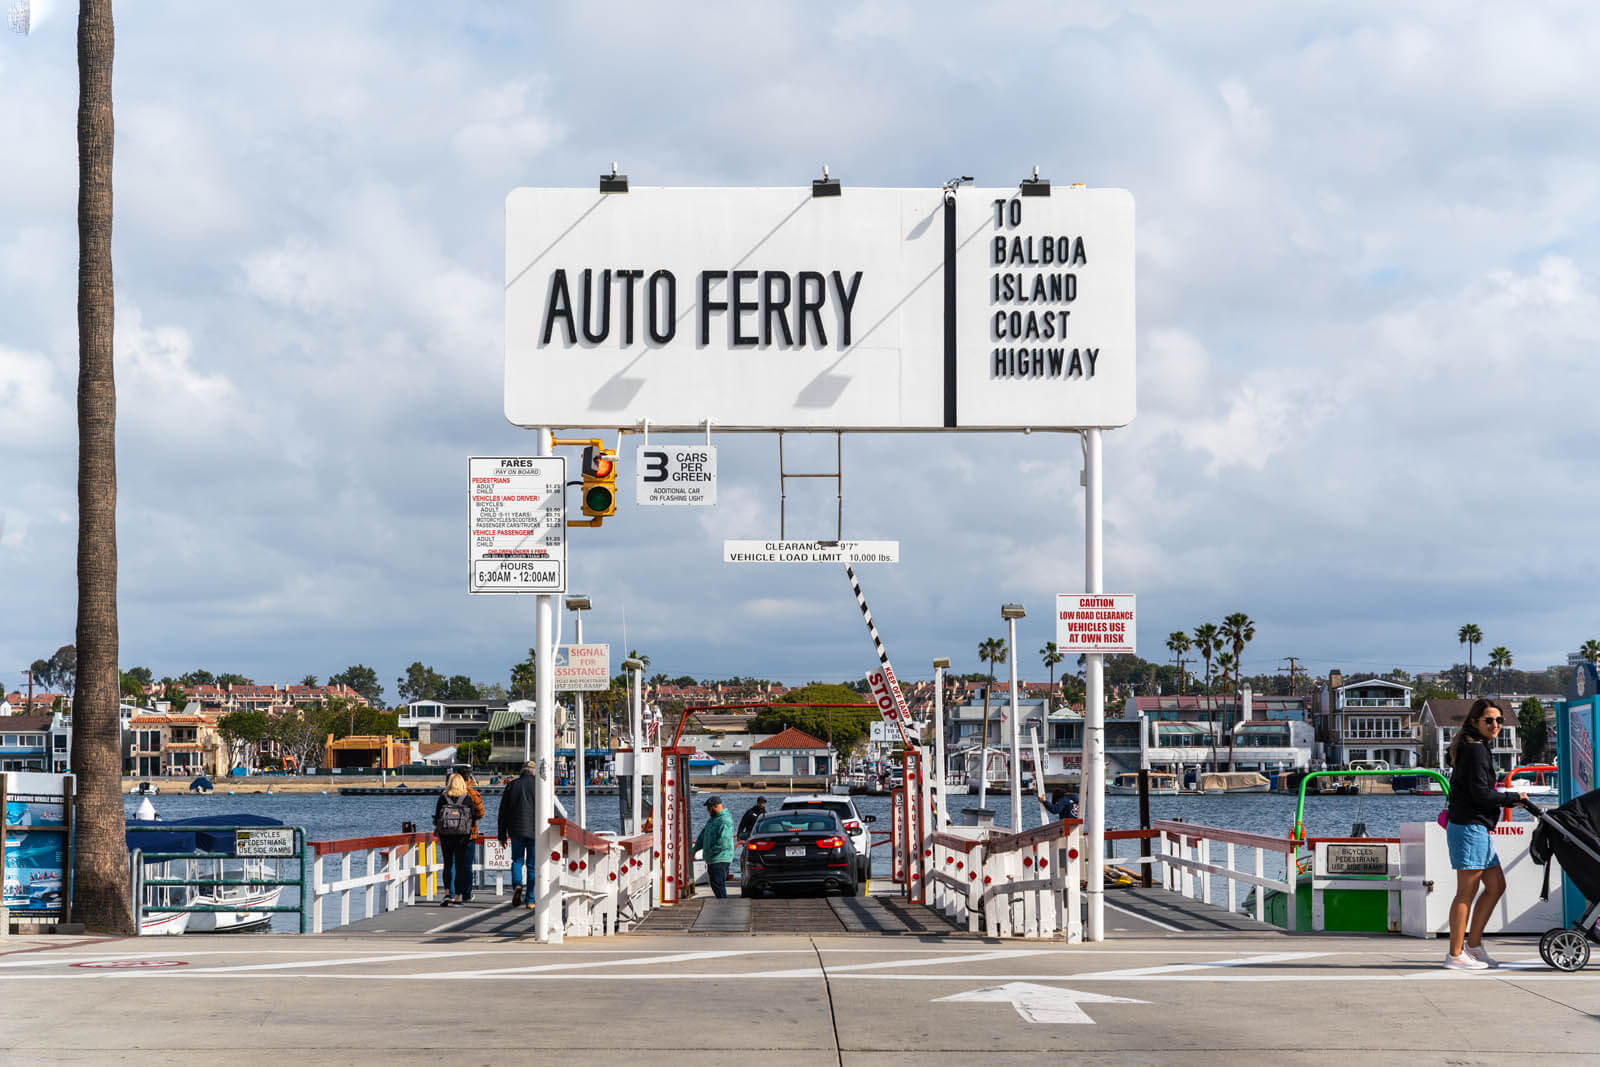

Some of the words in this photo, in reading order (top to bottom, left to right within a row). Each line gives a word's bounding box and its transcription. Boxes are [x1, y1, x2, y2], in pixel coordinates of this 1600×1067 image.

[994, 199, 1022, 227] TO
[995, 236, 1087, 265] BALBOA
[995, 273, 1077, 302] ISLAND
[542, 268, 677, 346] AUTO
[701, 270, 864, 347] FERRY
[995, 310, 1071, 340] COAST
[995, 347, 1101, 378] HIGHWAY
[676, 453, 708, 463] CARS
[501, 459, 534, 468] FARES
[643, 451, 669, 482] 3
[680, 463, 703, 472] PER
[672, 472, 712, 482] GREEN
[765, 543, 827, 551] CLEARANCE
[730, 553, 776, 562] VEHICLE
[779, 553, 809, 562] LOAD
[812, 553, 842, 562] LIMIT
[849, 553, 878, 562] 10,000
[878, 553, 893, 562] lbs.
[500, 562, 534, 570] HOURS
[519, 571, 556, 582] 12:00AM
[1079, 598, 1114, 607] CAUTION
[1059, 611, 1075, 620] LOW
[1076, 611, 1094, 620] ROAD
[1095, 611, 1133, 620] CLEARANCE
[1067, 622, 1107, 632] VEHICLES
[1109, 622, 1125, 632] USE
[1069, 633, 1080, 643] AT
[1081, 633, 1101, 643] OWN
[1103, 633, 1125, 643] RISK
[570, 648, 606, 656] SIGNAL
[580, 658, 597, 666] FOR
[556, 667, 607, 676] SSISTANCE
[869, 673, 898, 720] STOP
[884, 666, 896, 685] KEEP
[892, 686, 902, 698] OFF
[898, 700, 911, 719] RAMP
[668, 758, 674, 766] 3
